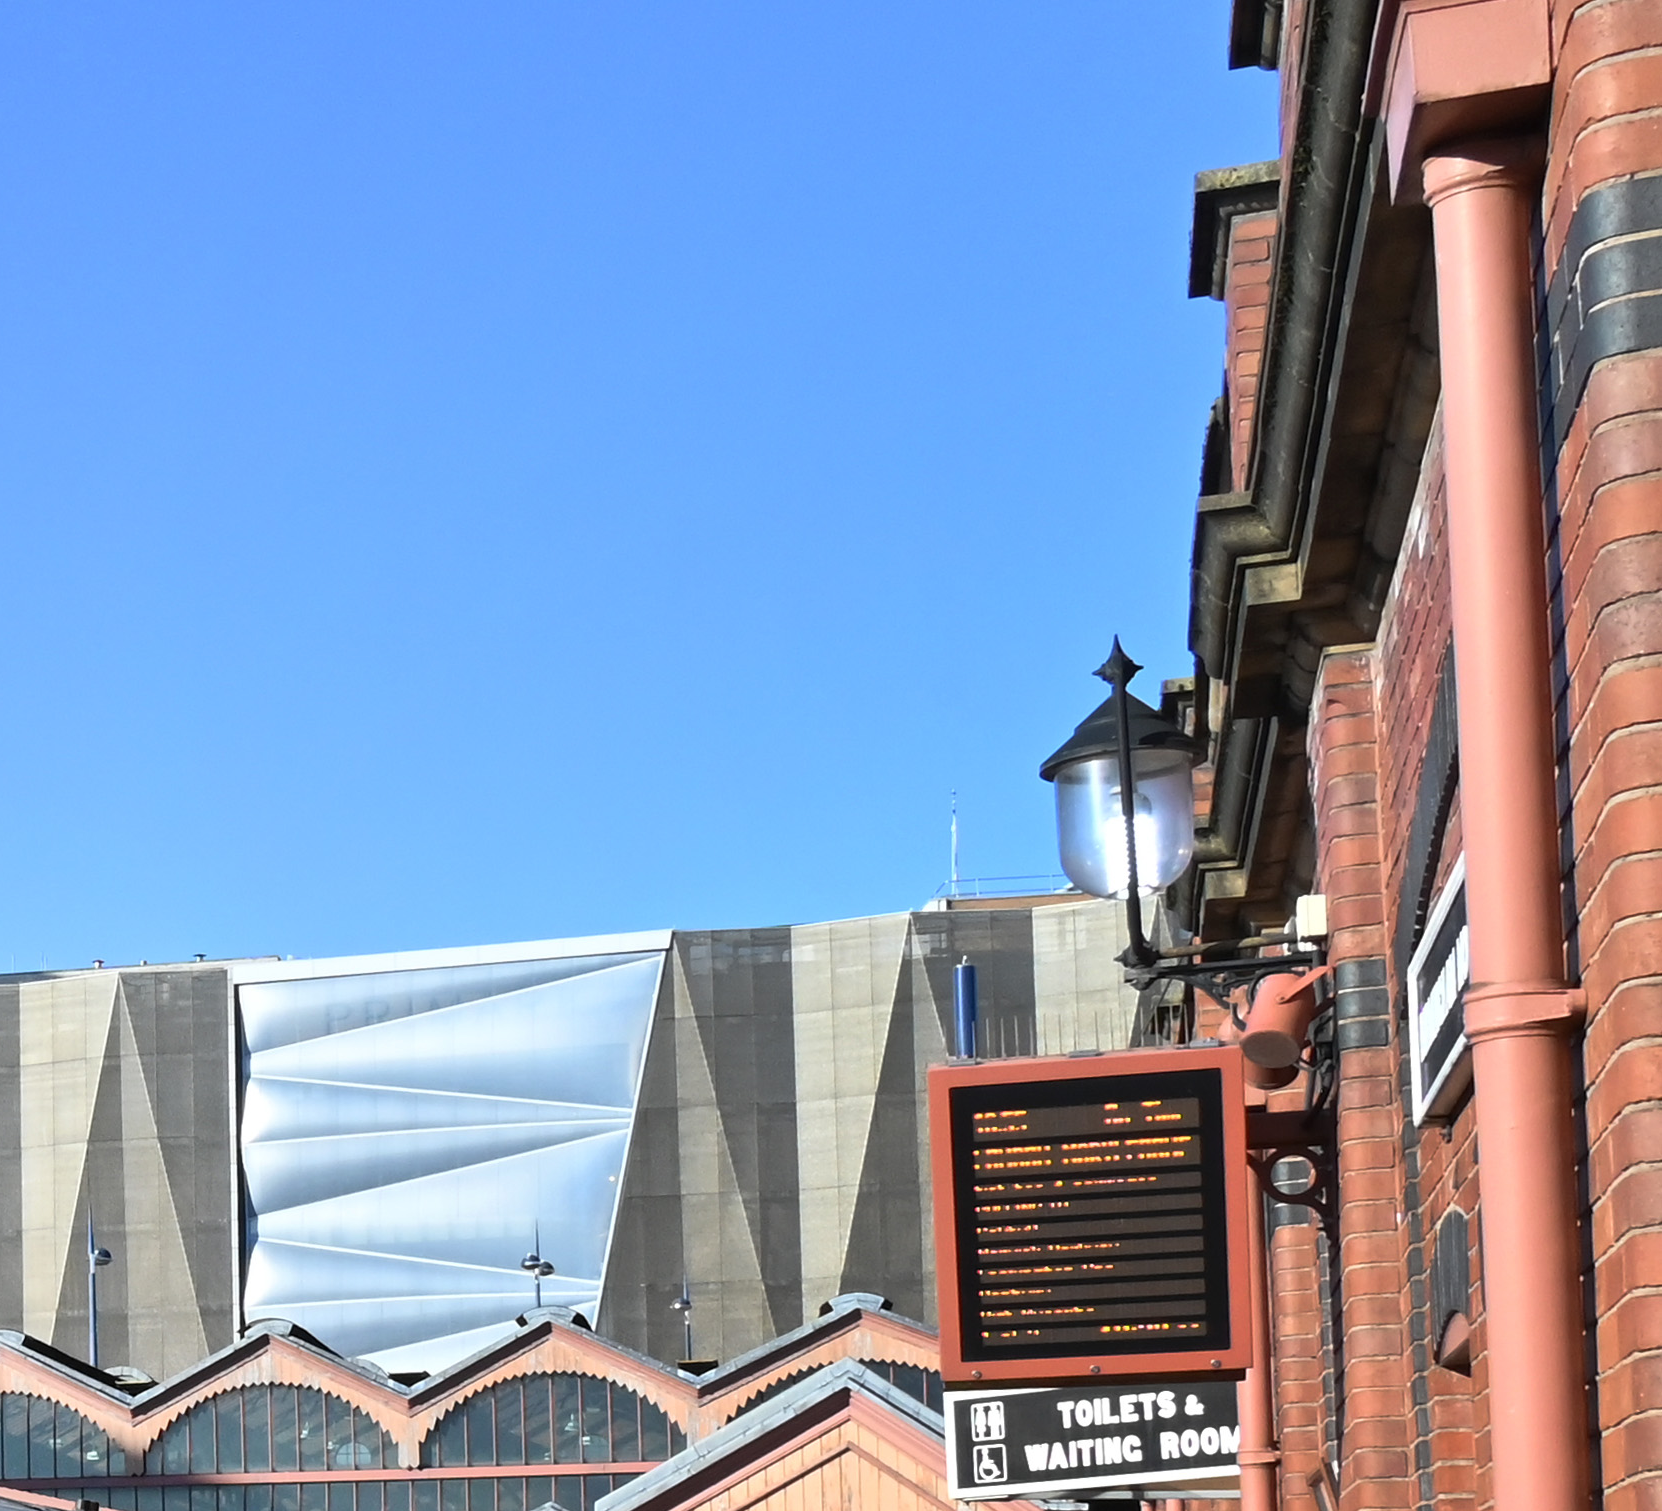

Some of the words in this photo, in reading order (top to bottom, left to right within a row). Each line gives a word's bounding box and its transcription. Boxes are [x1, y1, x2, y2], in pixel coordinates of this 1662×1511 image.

[1057, 1391, 1177, 1429] TOILETS
[1184, 1394, 1205, 1416] &
[1024, 1434, 1143, 1471] WAITING
[1159, 1424, 1241, 1460] ROOM
